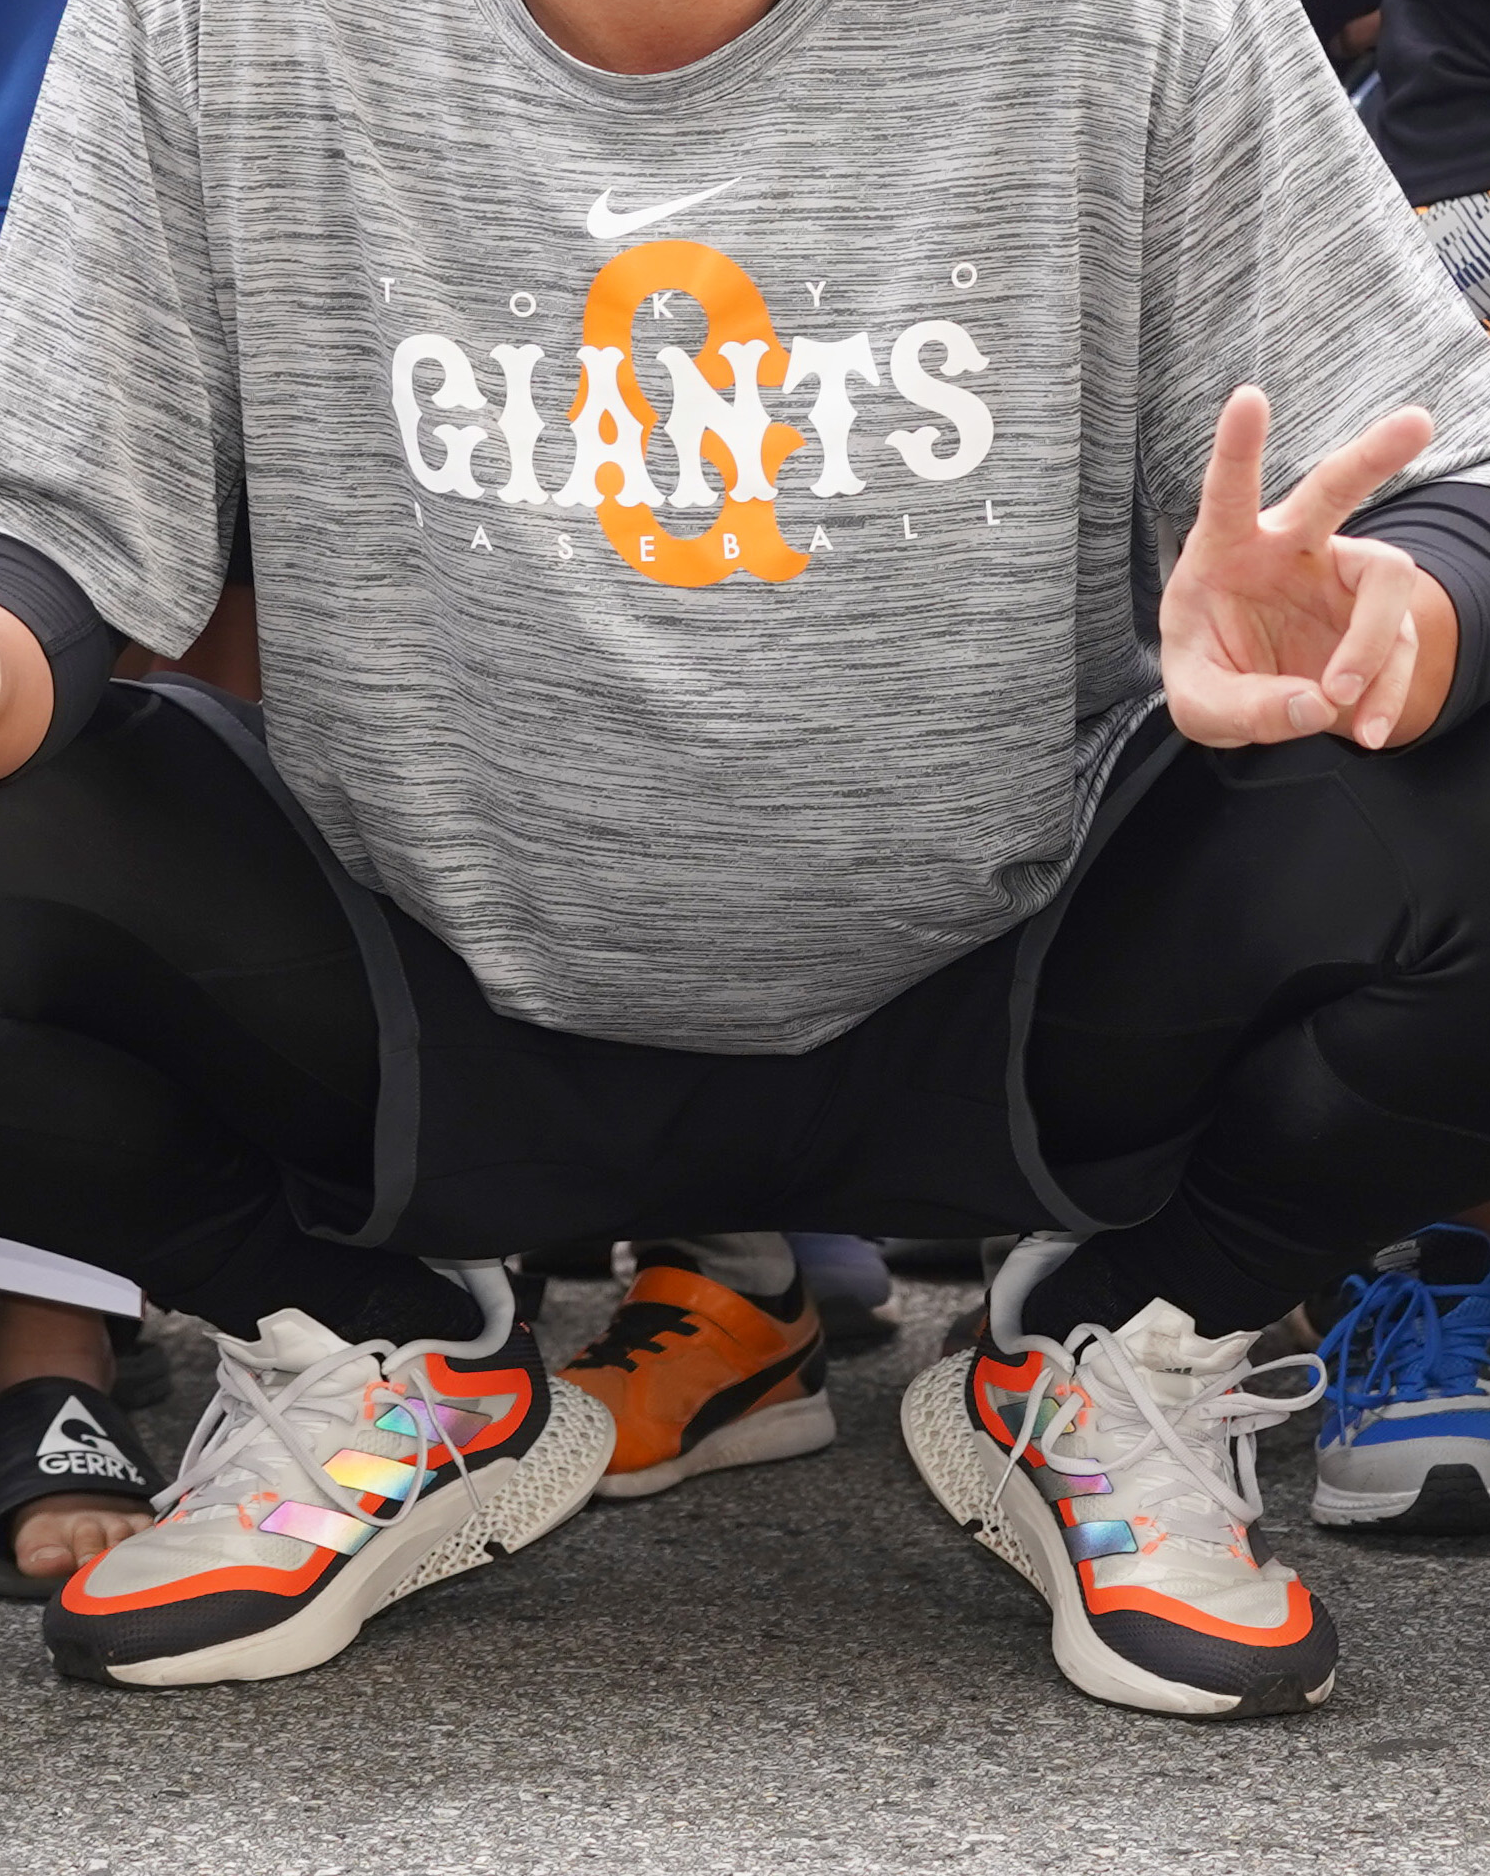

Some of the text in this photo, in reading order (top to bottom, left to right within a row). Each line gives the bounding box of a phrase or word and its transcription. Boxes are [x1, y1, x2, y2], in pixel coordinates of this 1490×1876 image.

[392, 319, 994, 508] GIANTS
[413, 499, 1001, 561] BASEBALL
[39, 1452, 141, 1482] GERRY
